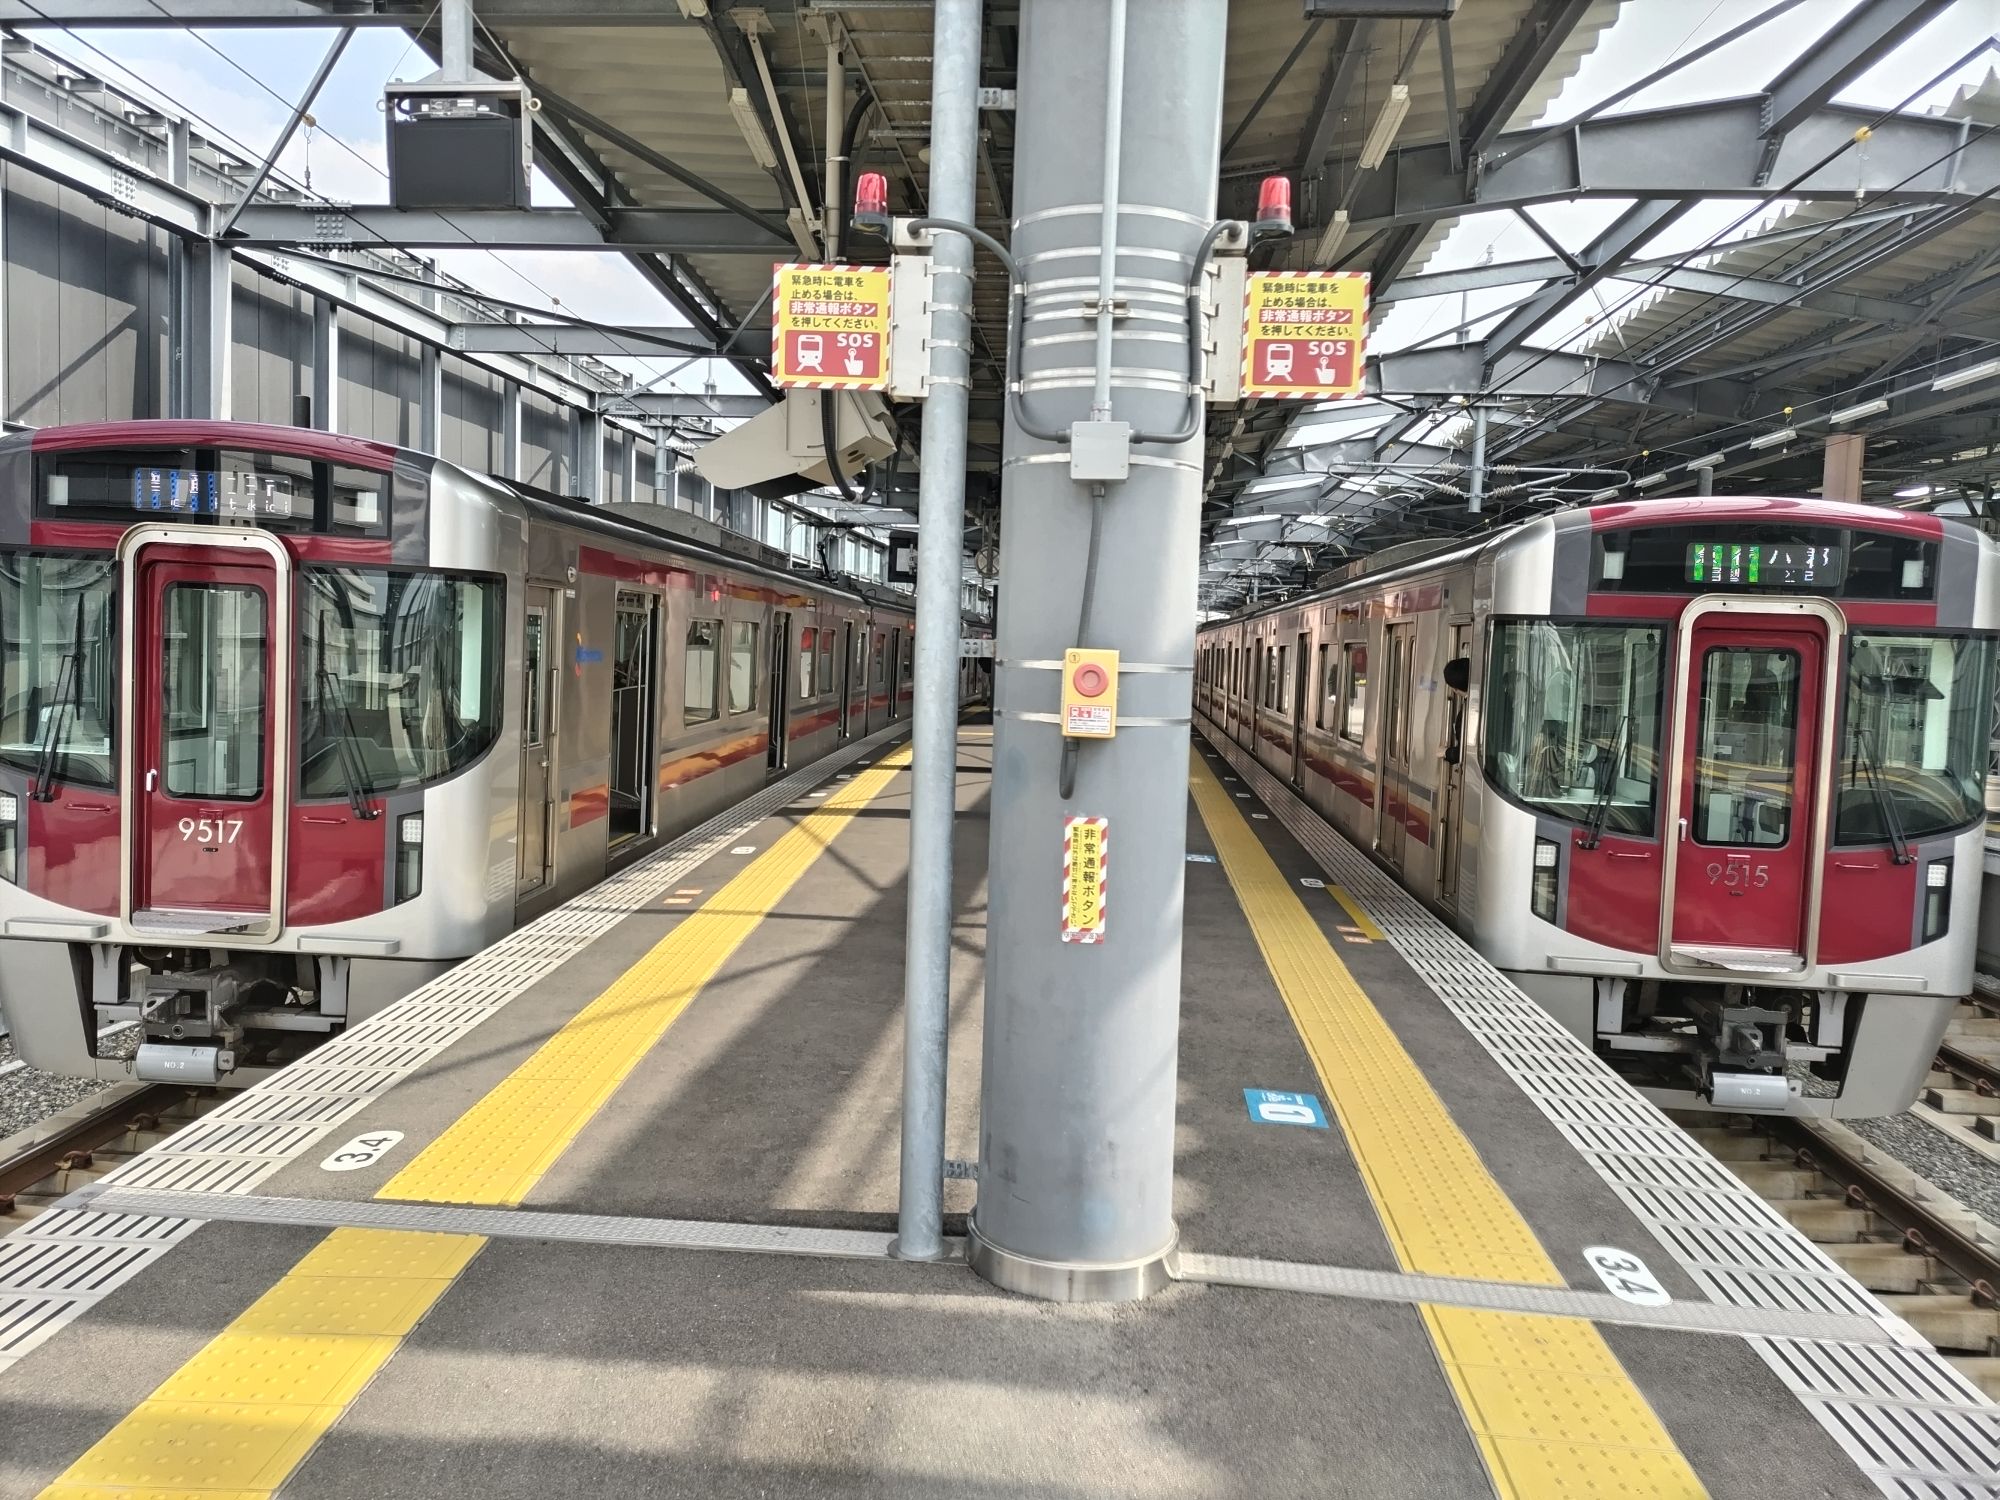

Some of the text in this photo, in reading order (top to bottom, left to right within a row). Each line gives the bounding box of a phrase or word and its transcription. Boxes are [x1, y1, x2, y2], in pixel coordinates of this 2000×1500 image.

[791, 275, 865, 287] 緊急時に電車を
[791, 289, 859, 301] 止める場合は、
[1262, 283, 1340, 294] 緊急時に電車を
[791, 302, 877, 316] 非常通報ボタン
[1261, 297, 1333, 308] 止める場合は、
[1261, 309, 1351, 323] 非常通報ボタン
[791, 317, 879, 330] を押してください。
[1261, 325, 1353, 337] を押してください。
[837, 333, 874, 348] SOS
[1308, 341, 1347, 356] SOS
[178, 817, 244, 844] 9517
[1082, 828, 1097, 925] 非常通報ボタン
[1706, 863, 1769, 888] 9515
[164, 1061, 185, 1070] NO.2
[333, 1137, 393, 1163] 3.4
[1594, 1255, 1660, 1295] 3.4
